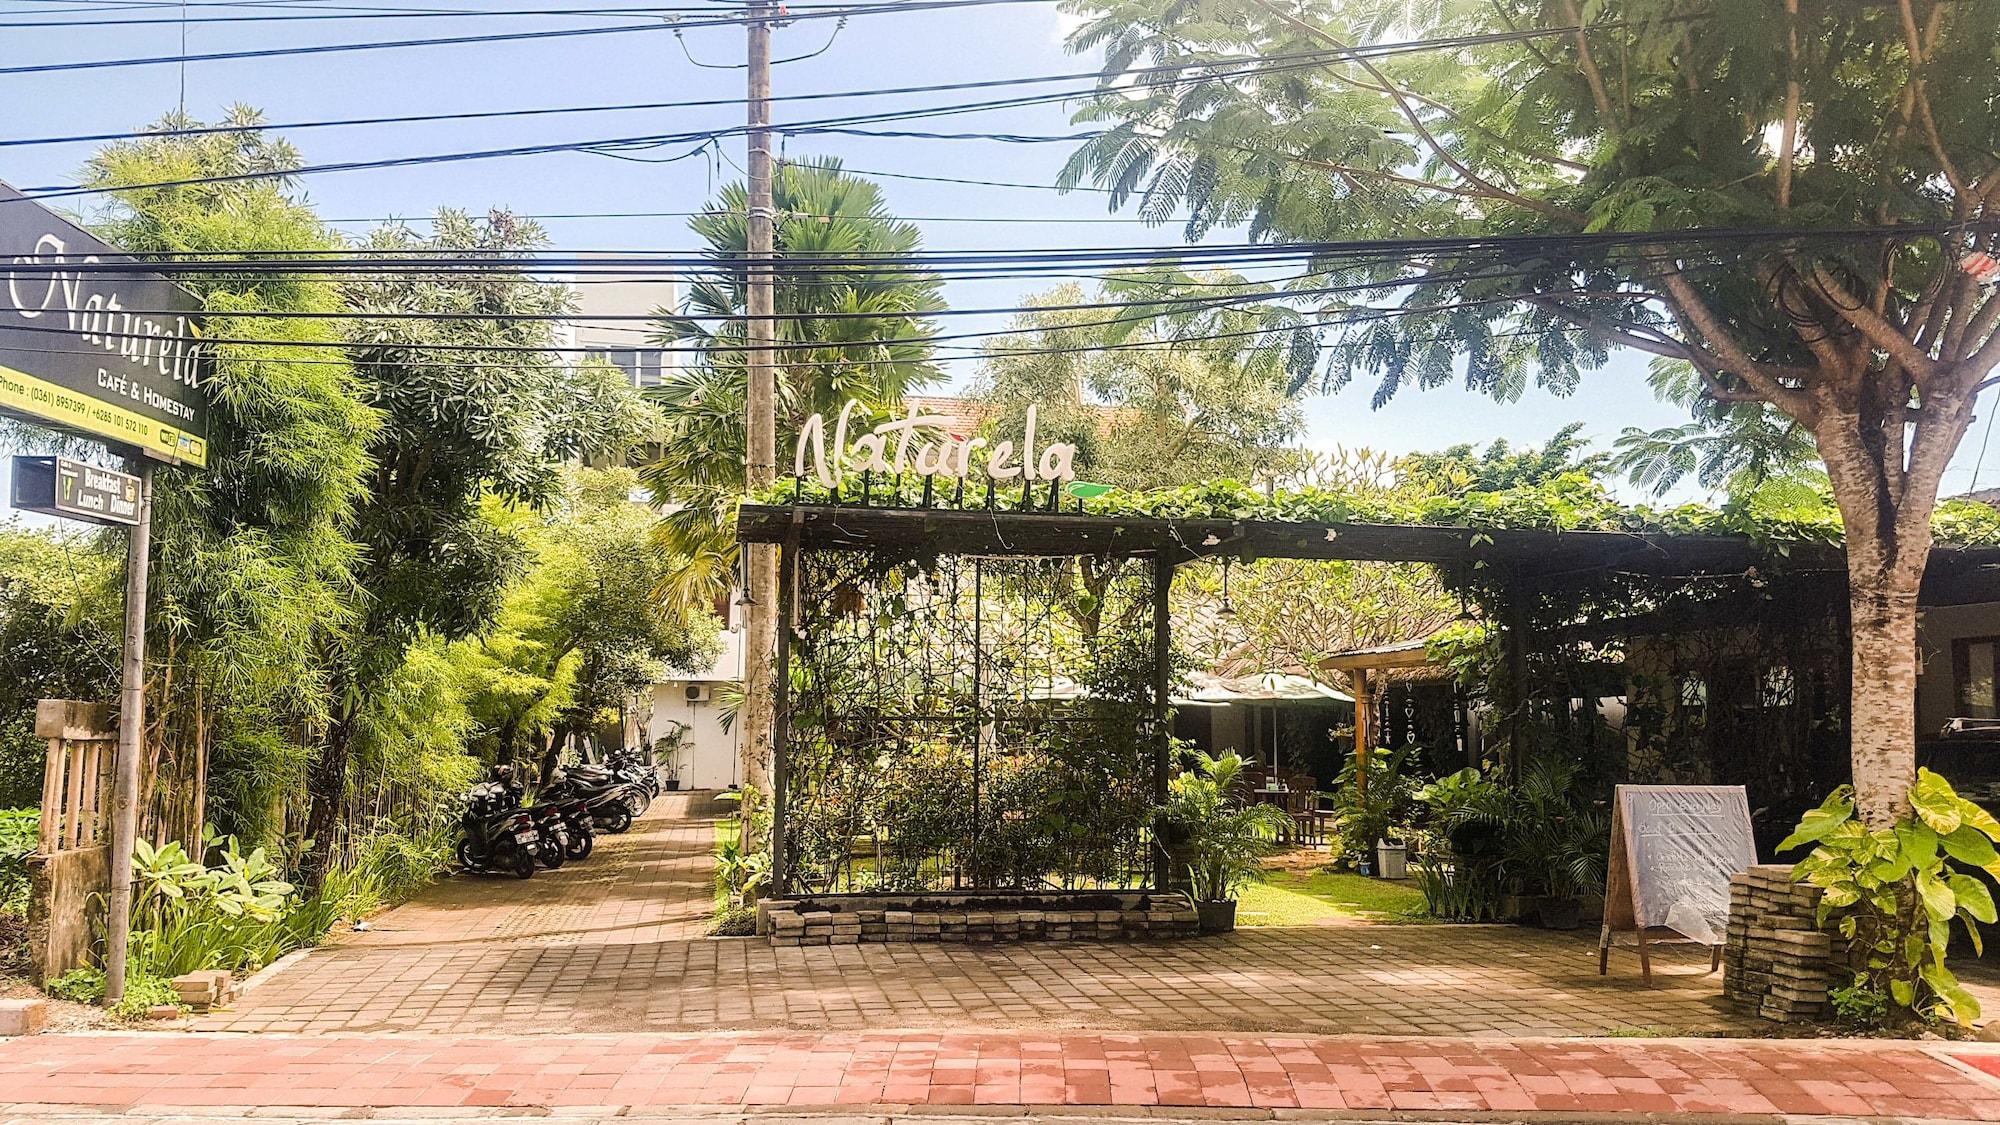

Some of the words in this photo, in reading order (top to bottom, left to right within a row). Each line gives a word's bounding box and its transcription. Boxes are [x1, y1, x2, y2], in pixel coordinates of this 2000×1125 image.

[9, 233, 199, 389] Naturela
[31, 387, 54, 407] (0361)
[125, 418, 137, 432] 572
[130, 382, 140, 401] &
[795, 398, 1076, 489] Naturela
[85, 468, 121, 494] Breakfast
[77, 488, 104, 511] Lunch
[110, 494, 135, 516] Dinner
